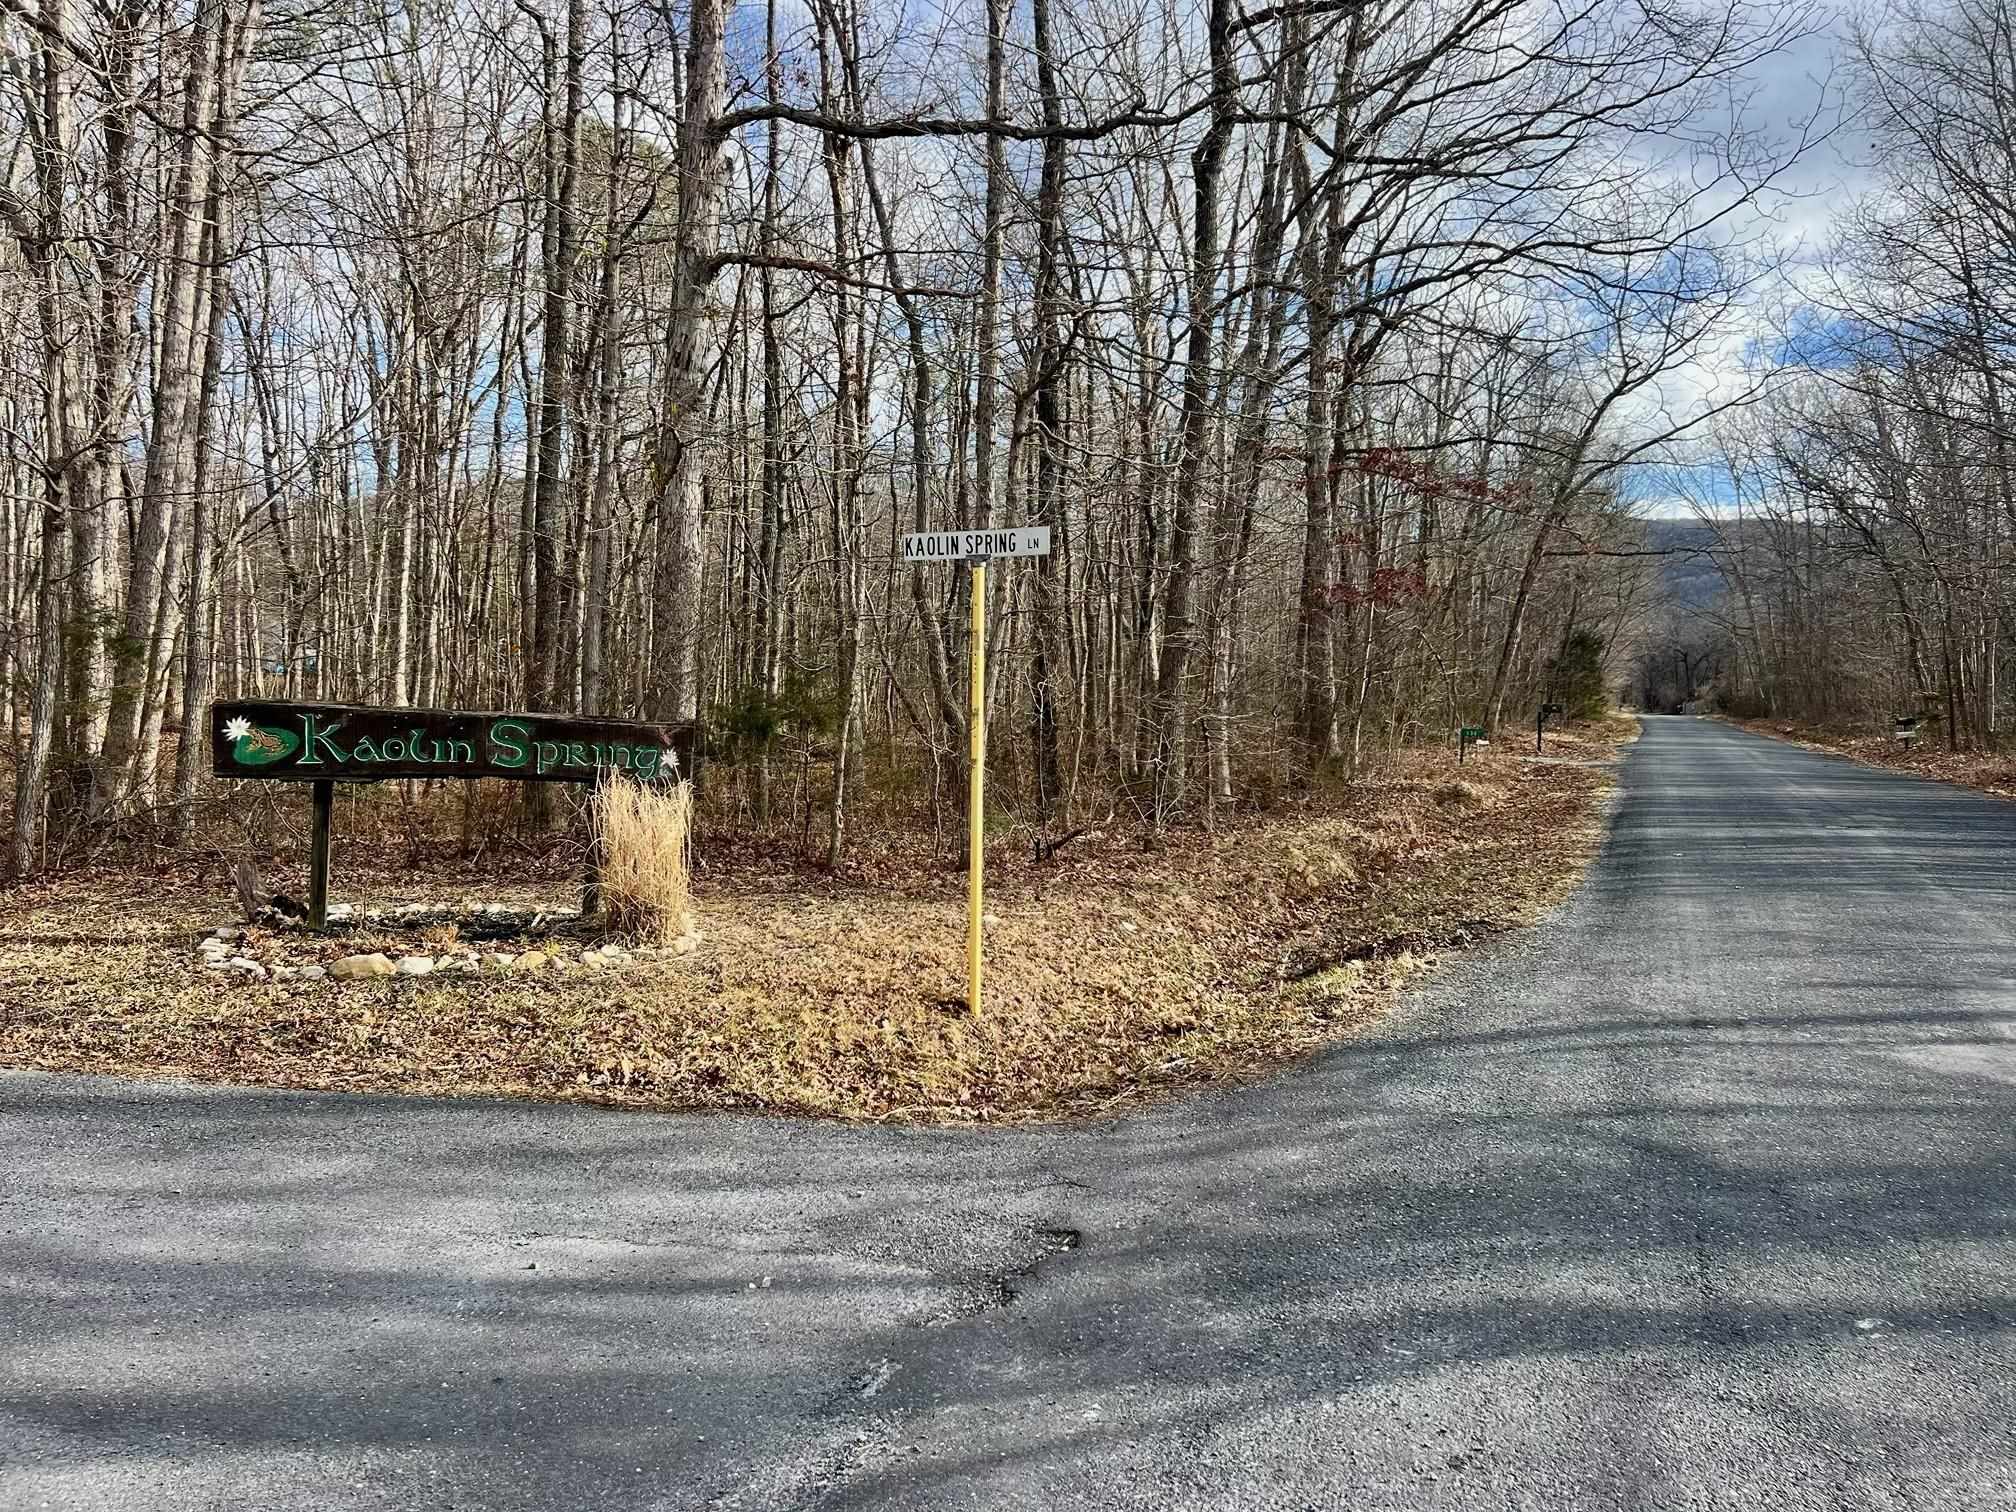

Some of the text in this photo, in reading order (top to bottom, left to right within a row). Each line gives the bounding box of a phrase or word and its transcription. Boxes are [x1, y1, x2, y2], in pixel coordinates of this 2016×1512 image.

[905, 533, 1039, 557] KAOLIN SPRING LN
[296, 713, 659, 777] Kaolin Spring
